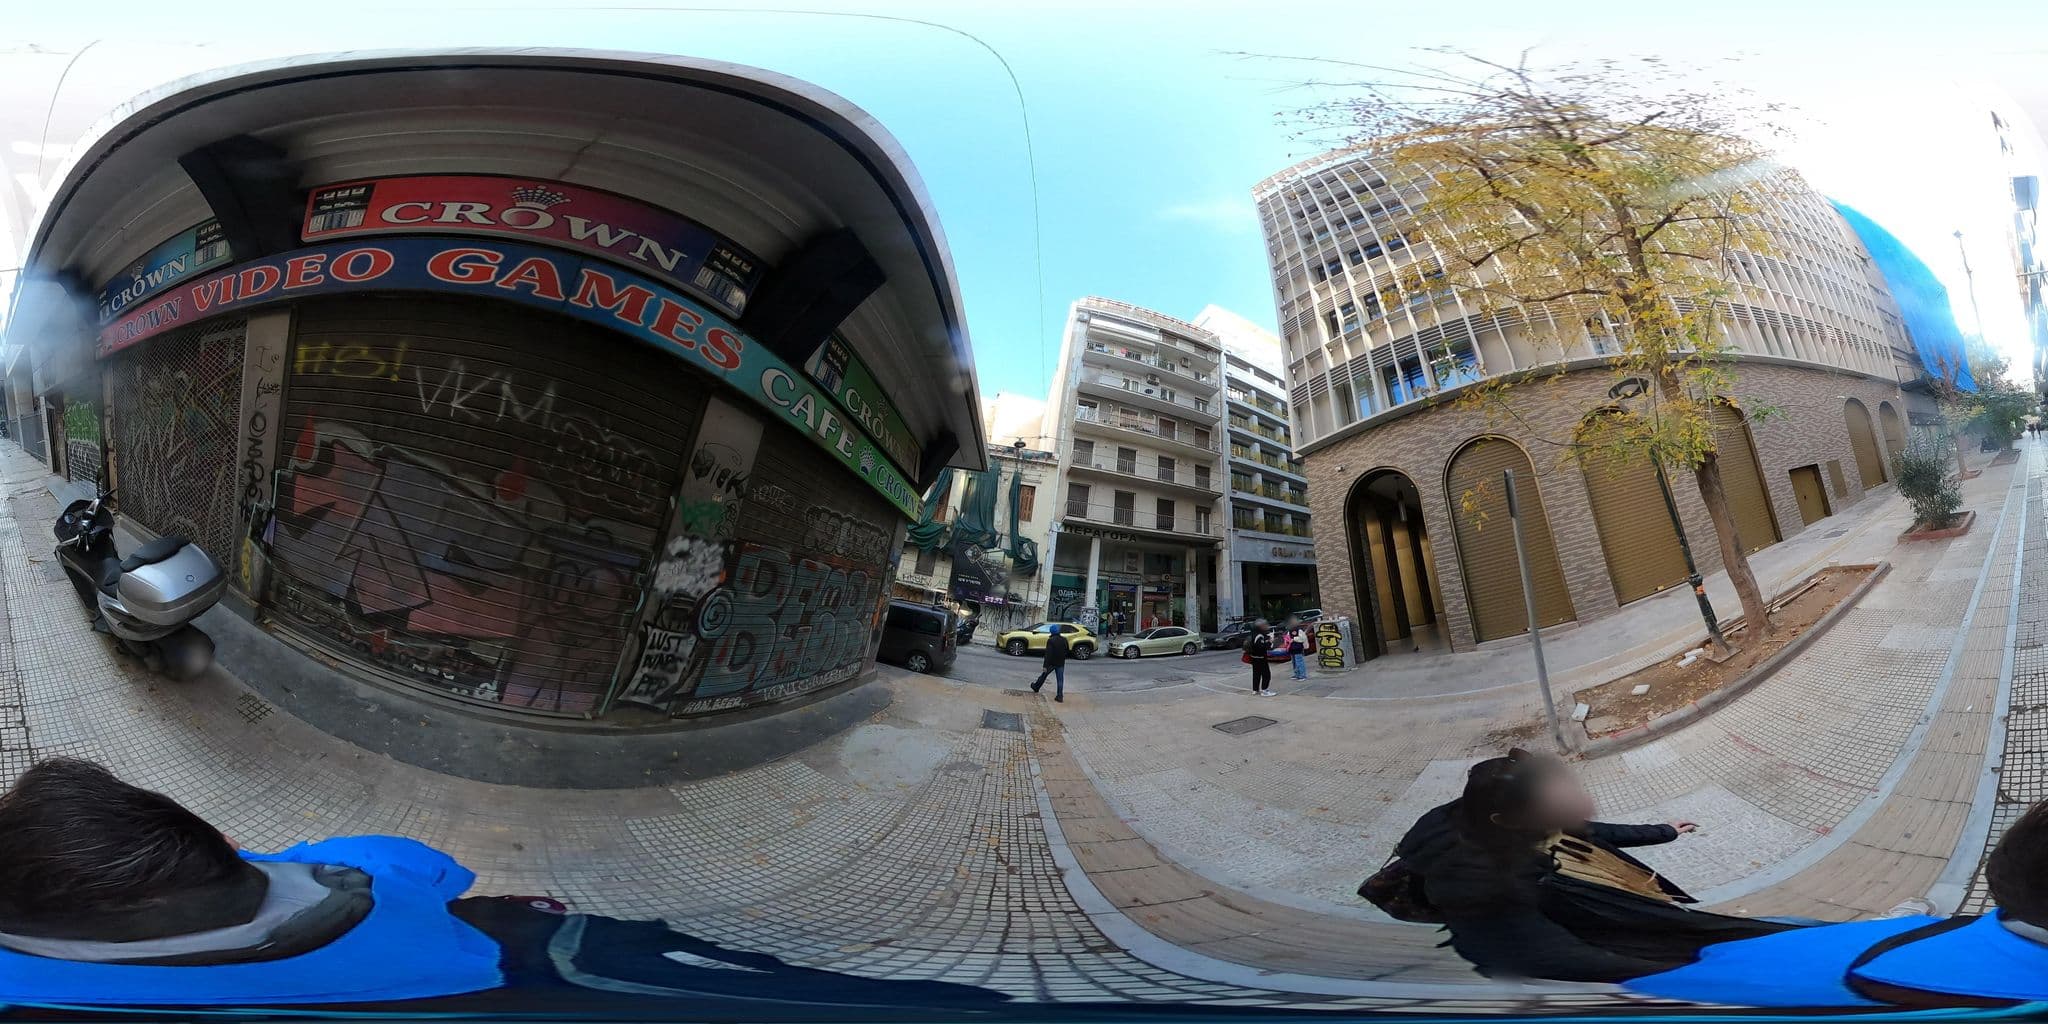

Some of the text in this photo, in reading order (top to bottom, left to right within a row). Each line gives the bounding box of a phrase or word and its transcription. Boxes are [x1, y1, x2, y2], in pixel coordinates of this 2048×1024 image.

[380, 201, 689, 274] CROWN
[111, 252, 189, 312] CROWN
[117, 248, 917, 515] CROWN VIDEO GAMES CAFE CROWN
[844, 386, 907, 463] CROWN
